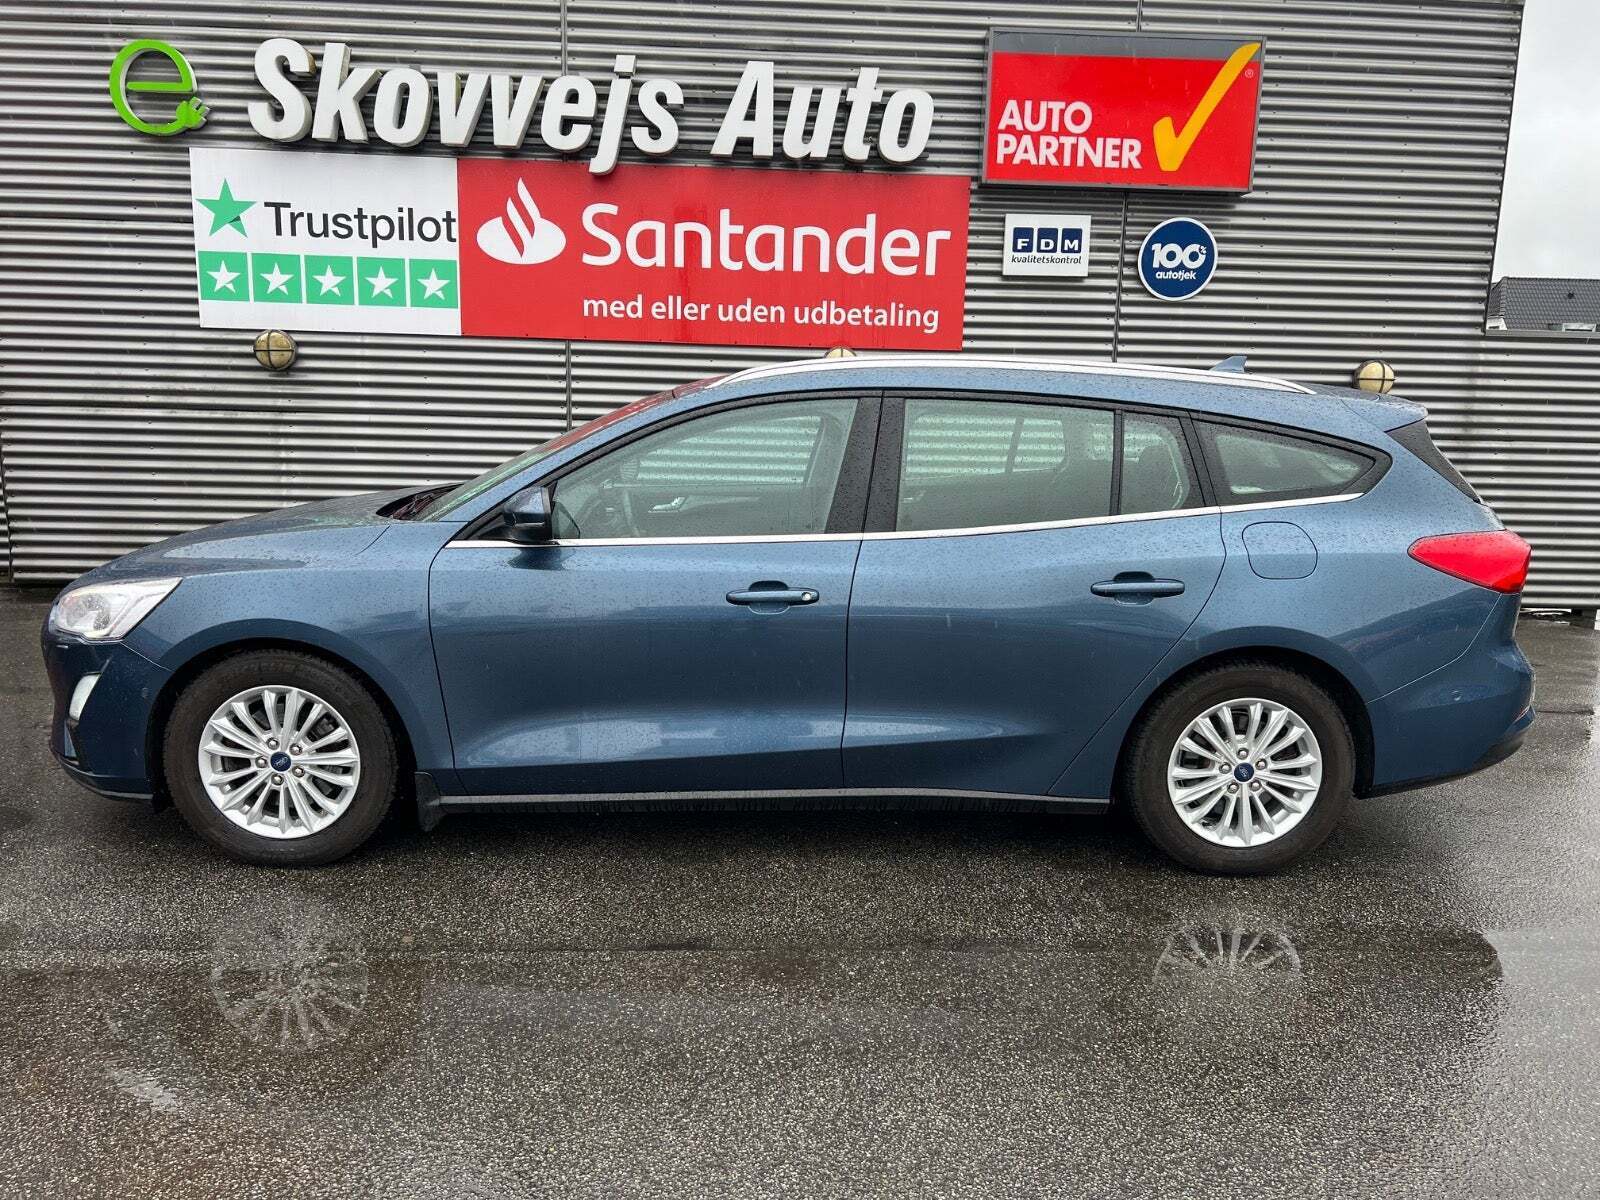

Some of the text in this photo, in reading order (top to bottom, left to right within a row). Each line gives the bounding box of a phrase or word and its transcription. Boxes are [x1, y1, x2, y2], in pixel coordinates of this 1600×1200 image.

[247, 38, 935, 176] Skovvejs Auto
[998, 99, 1093, 135] AUTO
[996, 134, 1143, 170] PARTNER
[263, 201, 457, 249] Trustpilot
[581, 203, 951, 276] Santander
[1011, 254, 1082, 265] kvalitetskontrol
[1015, 236, 1080, 252] FDM
[1155, 269, 1197, 281] autotjek
[583, 295, 940, 334] med eller uden udbetaling
